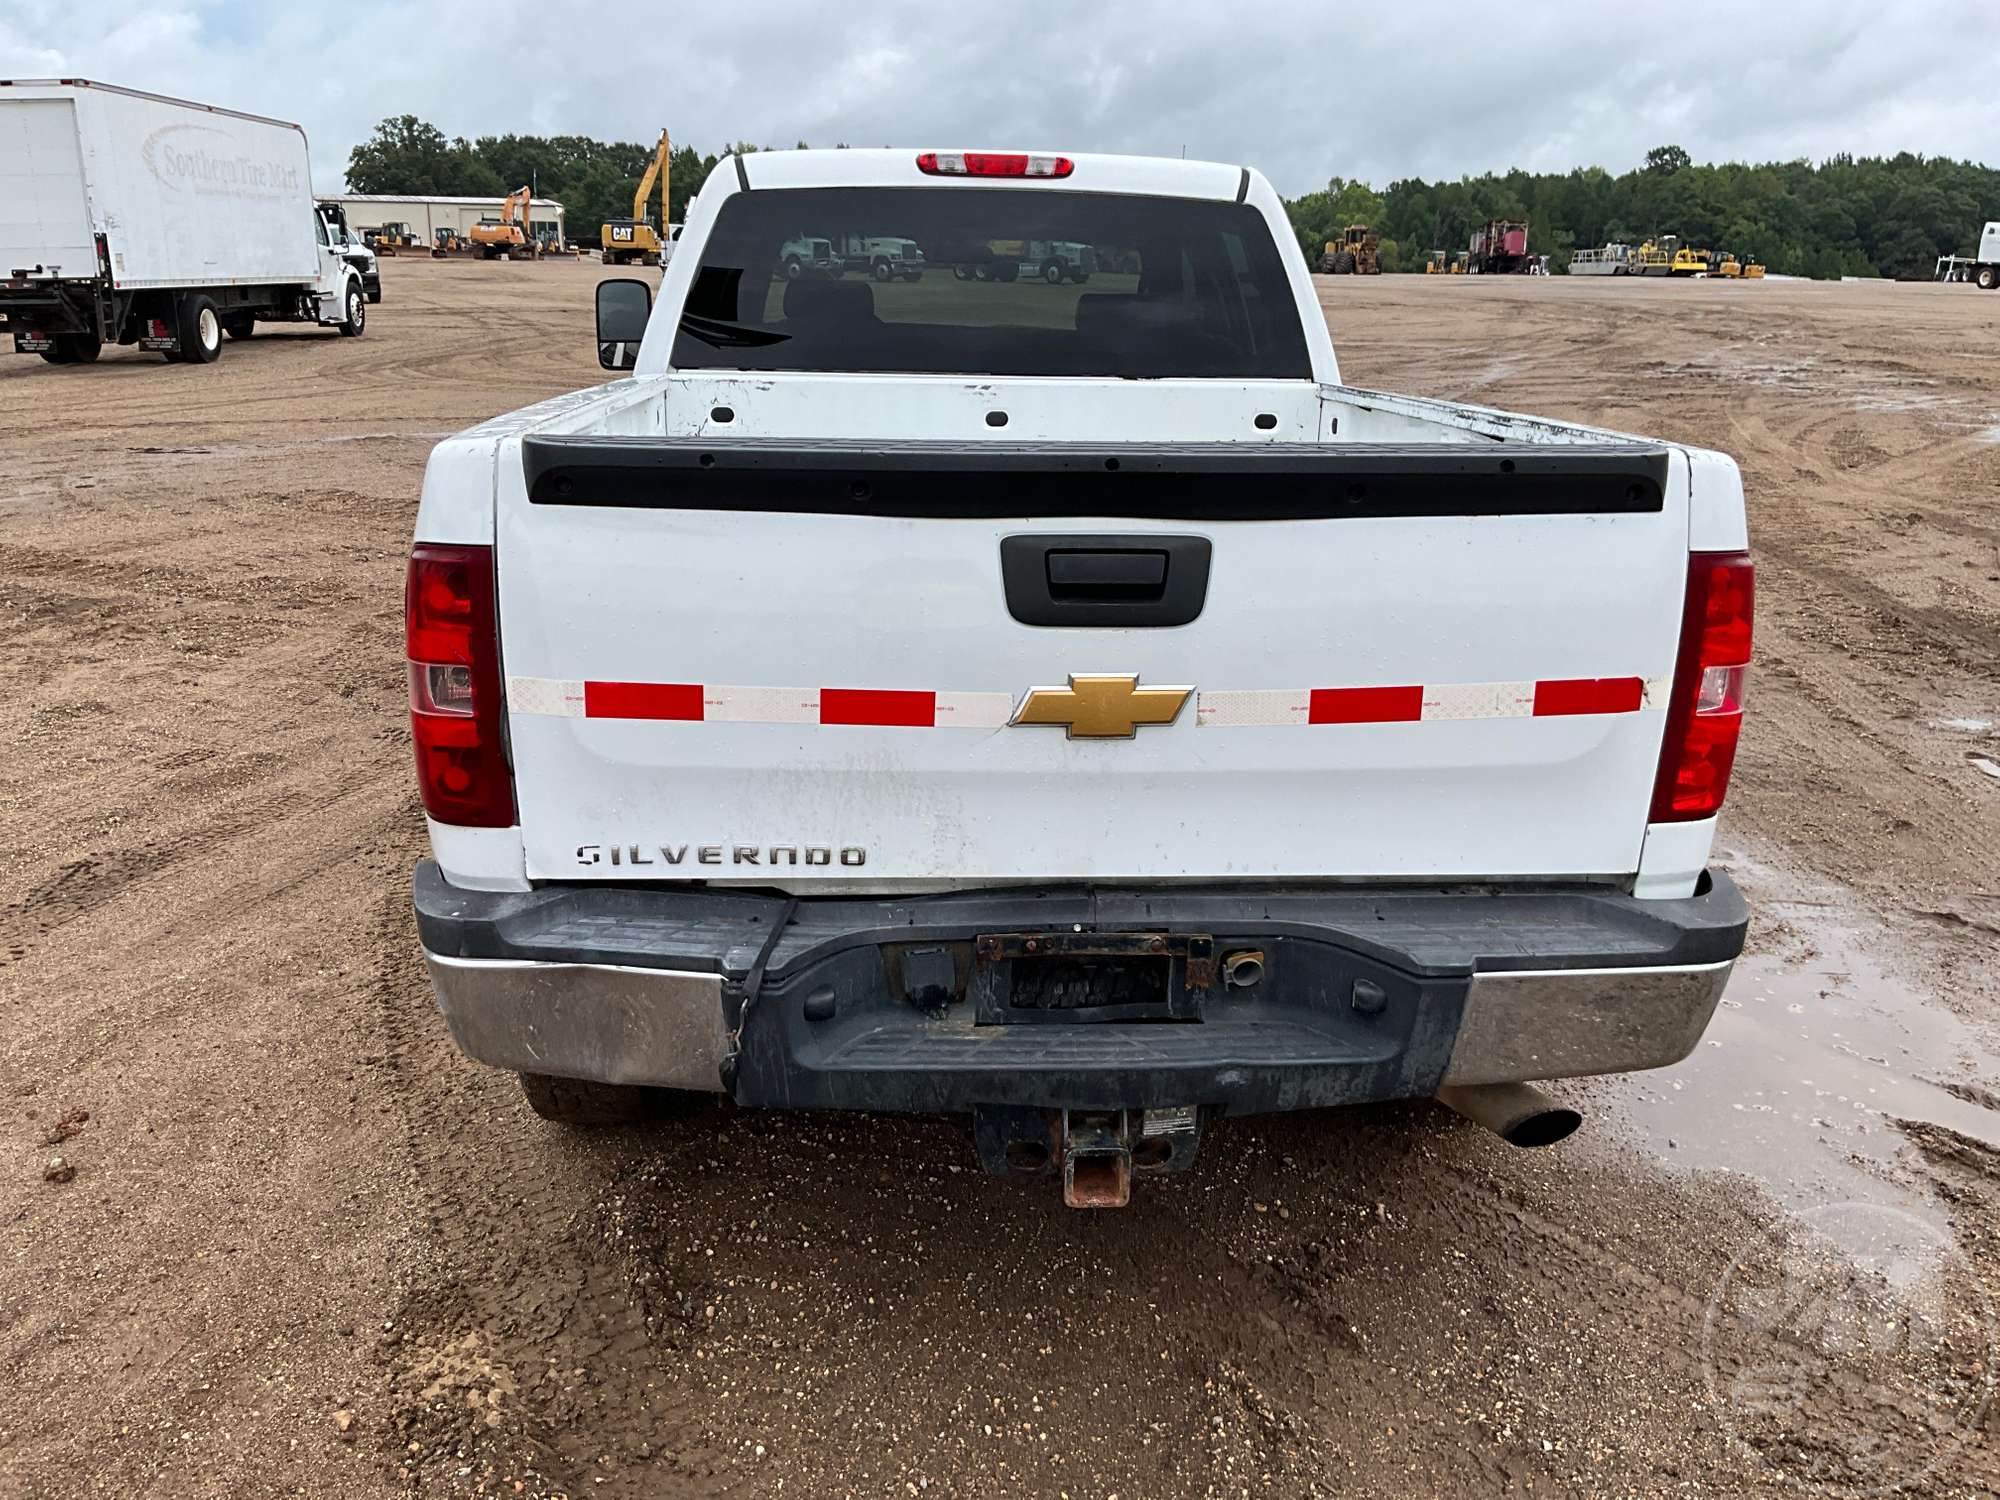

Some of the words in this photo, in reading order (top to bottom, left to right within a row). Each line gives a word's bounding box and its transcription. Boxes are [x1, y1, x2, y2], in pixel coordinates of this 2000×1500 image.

[163, 143, 238, 185] Southern
[613, 227, 632, 240] CAT
[576, 844, 867, 866] SILVERADO
